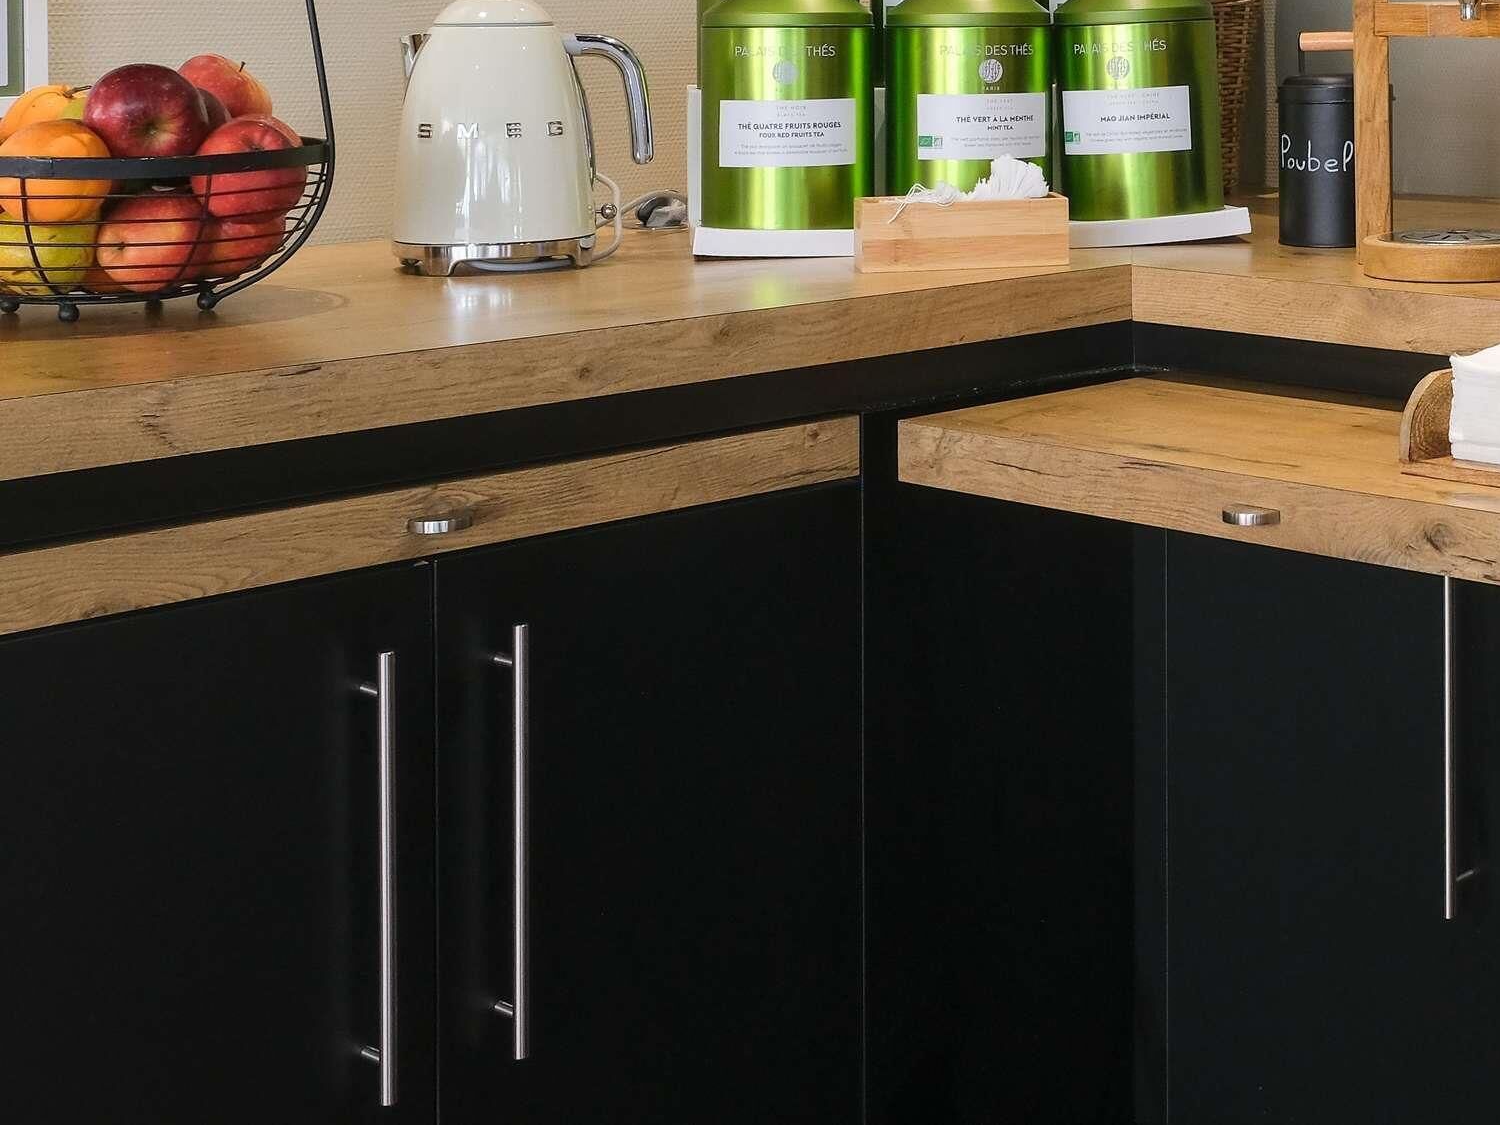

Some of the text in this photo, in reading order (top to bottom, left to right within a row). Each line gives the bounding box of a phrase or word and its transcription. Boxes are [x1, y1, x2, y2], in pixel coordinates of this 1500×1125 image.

[805, 43, 837, 57] THÉS
[939, 42, 1034, 57] PALS DES THÉS
[1138, 37, 1167, 52] HÉS
[972, 115, 991, 123] VERT
[1009, 114, 1034, 122] MENTHE
[1100, 115, 1117, 123] MAO
[1118, 114, 1135, 122] JIAN
[416, 121, 565, 140] SMEG
[738, 120, 842, 132] THÉ QUATRE FRUITS ROUGES
